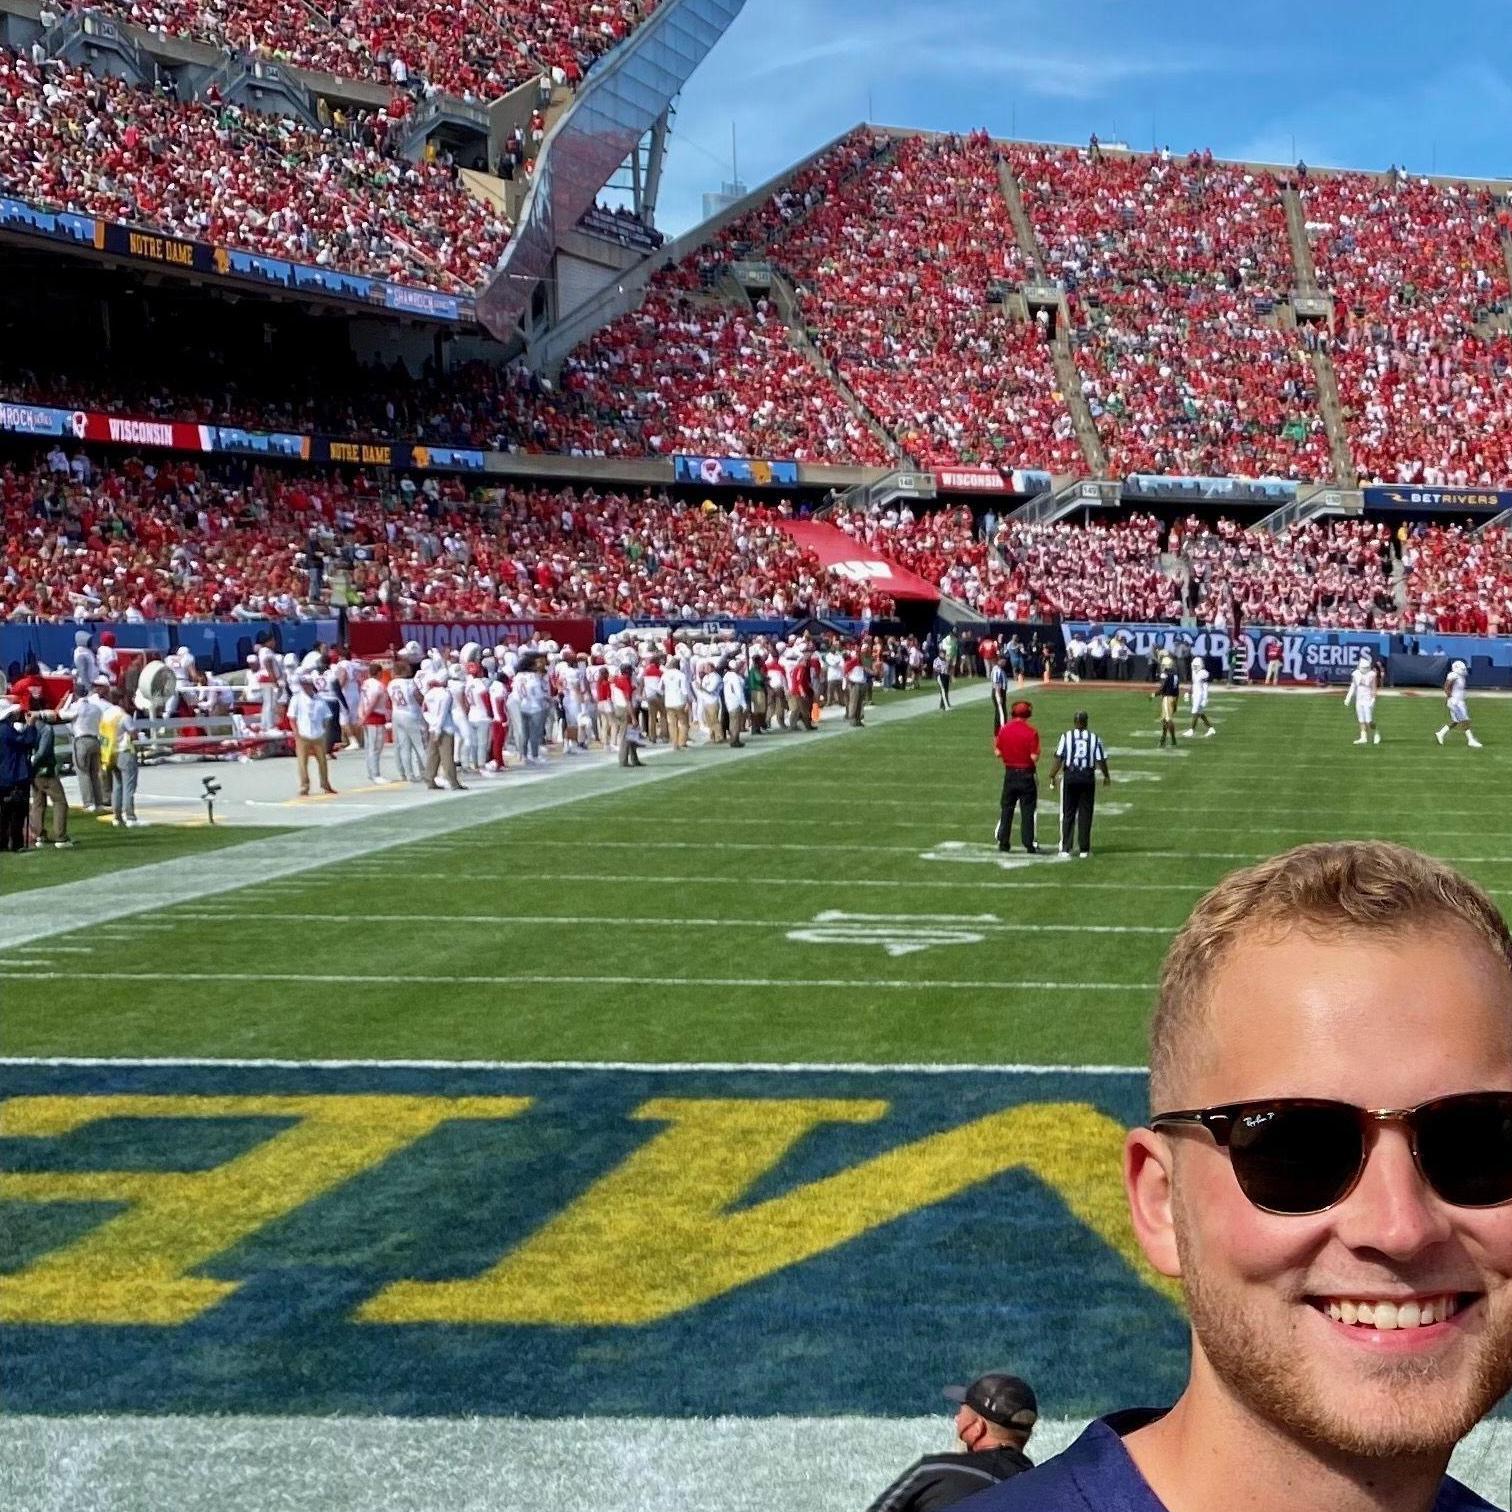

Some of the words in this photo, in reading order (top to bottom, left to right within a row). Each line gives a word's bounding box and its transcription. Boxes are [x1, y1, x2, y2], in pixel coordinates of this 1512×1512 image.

[129, 232, 163, 259] NOTRE
[165, 240, 194, 266] DAME
[108, 418, 173, 447] WISCONSIN
[329, 442, 360, 463] NOTRE
[362, 444, 392, 464] DAME
[941, 472, 1004, 488] WISCONSIN
[1410, 493, 1499, 505] BETRIVERS
[1308, 644, 1373, 665] SERIES
